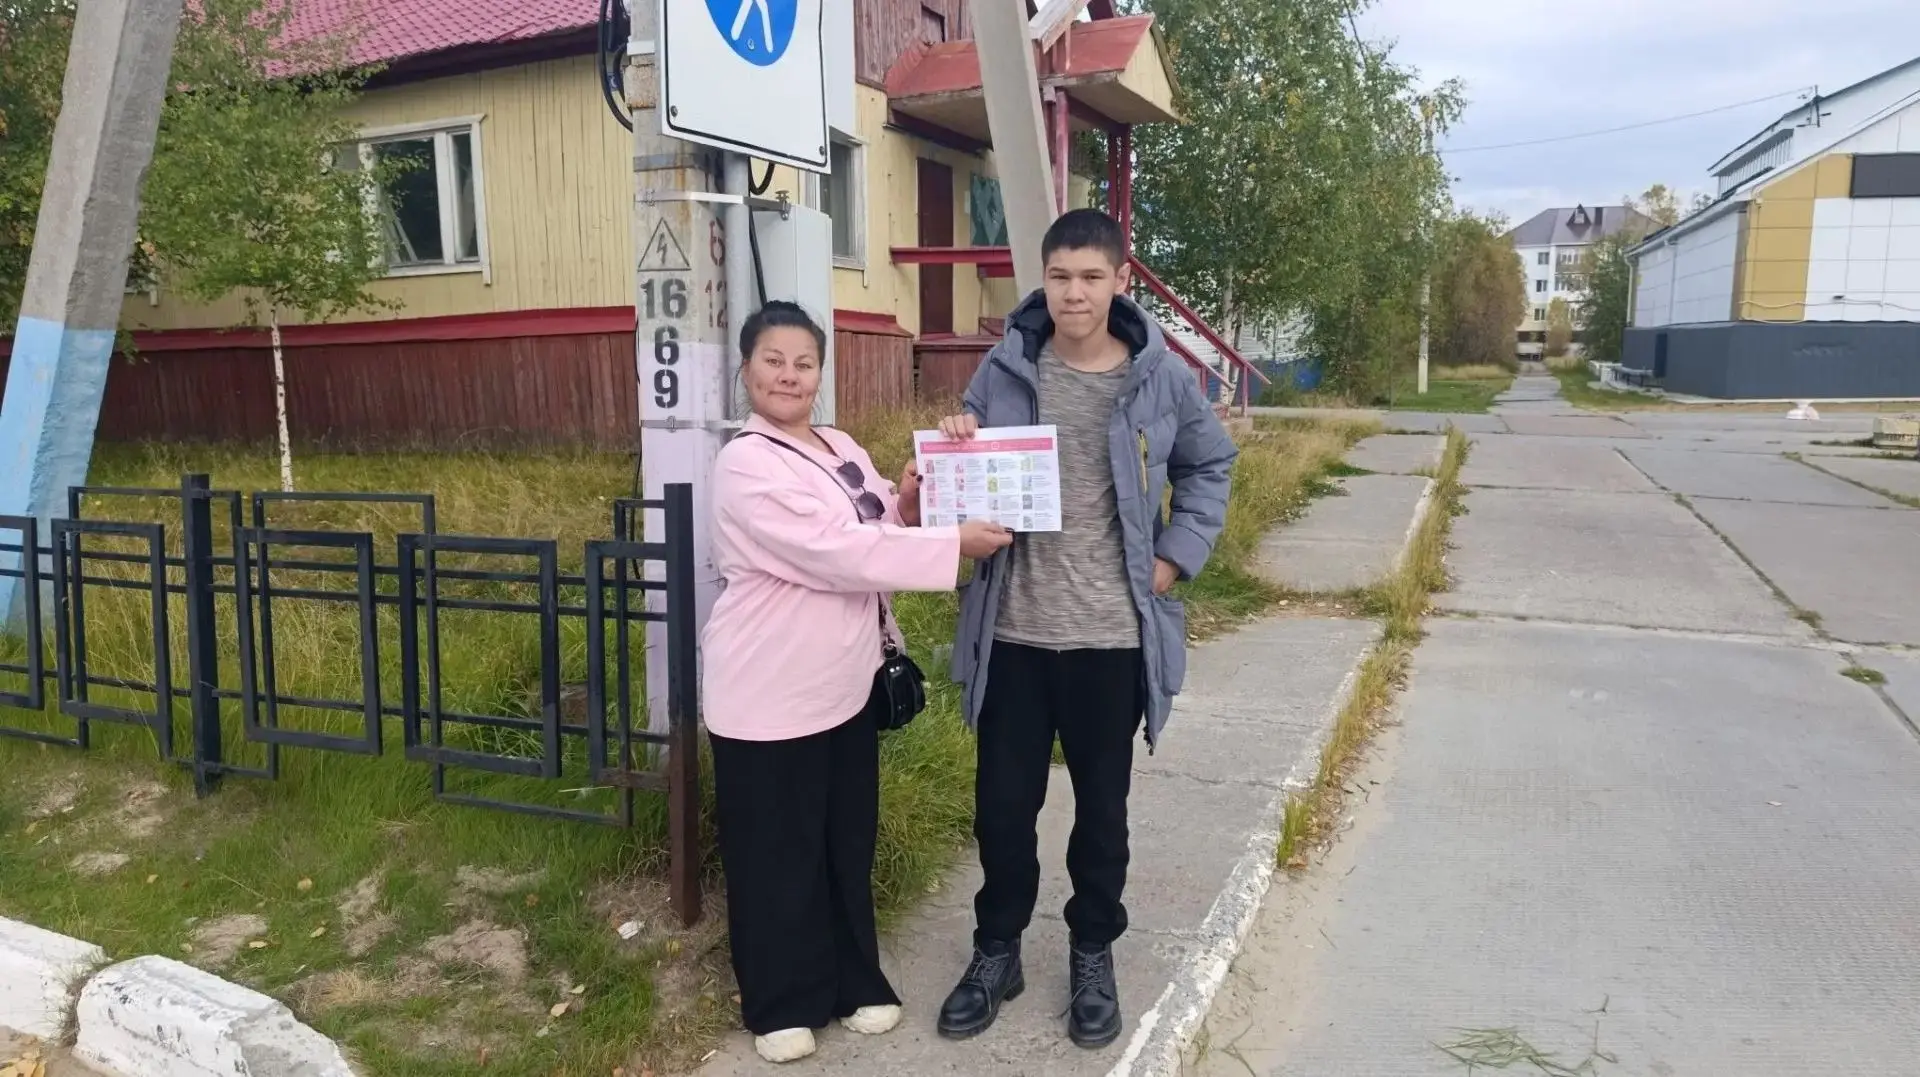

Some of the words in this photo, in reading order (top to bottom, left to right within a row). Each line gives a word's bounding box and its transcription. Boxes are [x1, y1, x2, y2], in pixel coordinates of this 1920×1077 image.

[640, 278, 688, 319] 16
[654, 325, 679, 366] 6
[653, 369, 679, 409] 9
